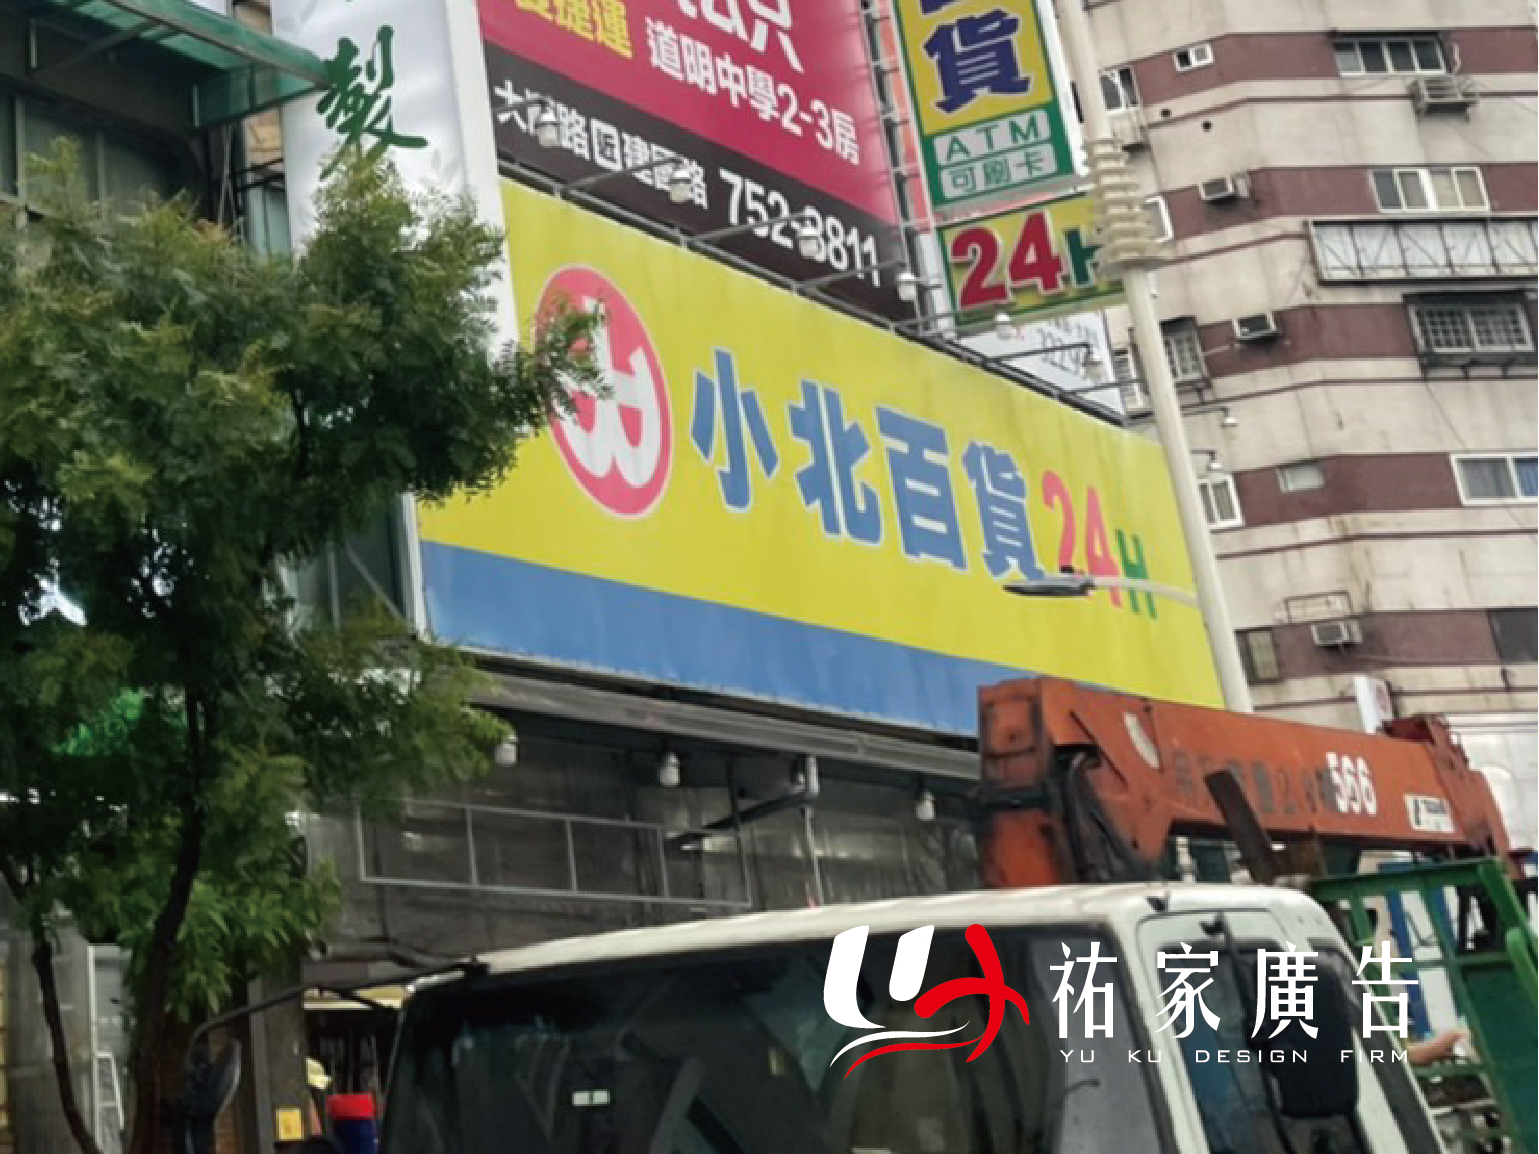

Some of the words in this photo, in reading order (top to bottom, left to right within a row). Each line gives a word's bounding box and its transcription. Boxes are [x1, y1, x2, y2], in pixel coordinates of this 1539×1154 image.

[946, 115, 1040, 162] ATM
[950, 150, 1045, 193] 可刷卡
